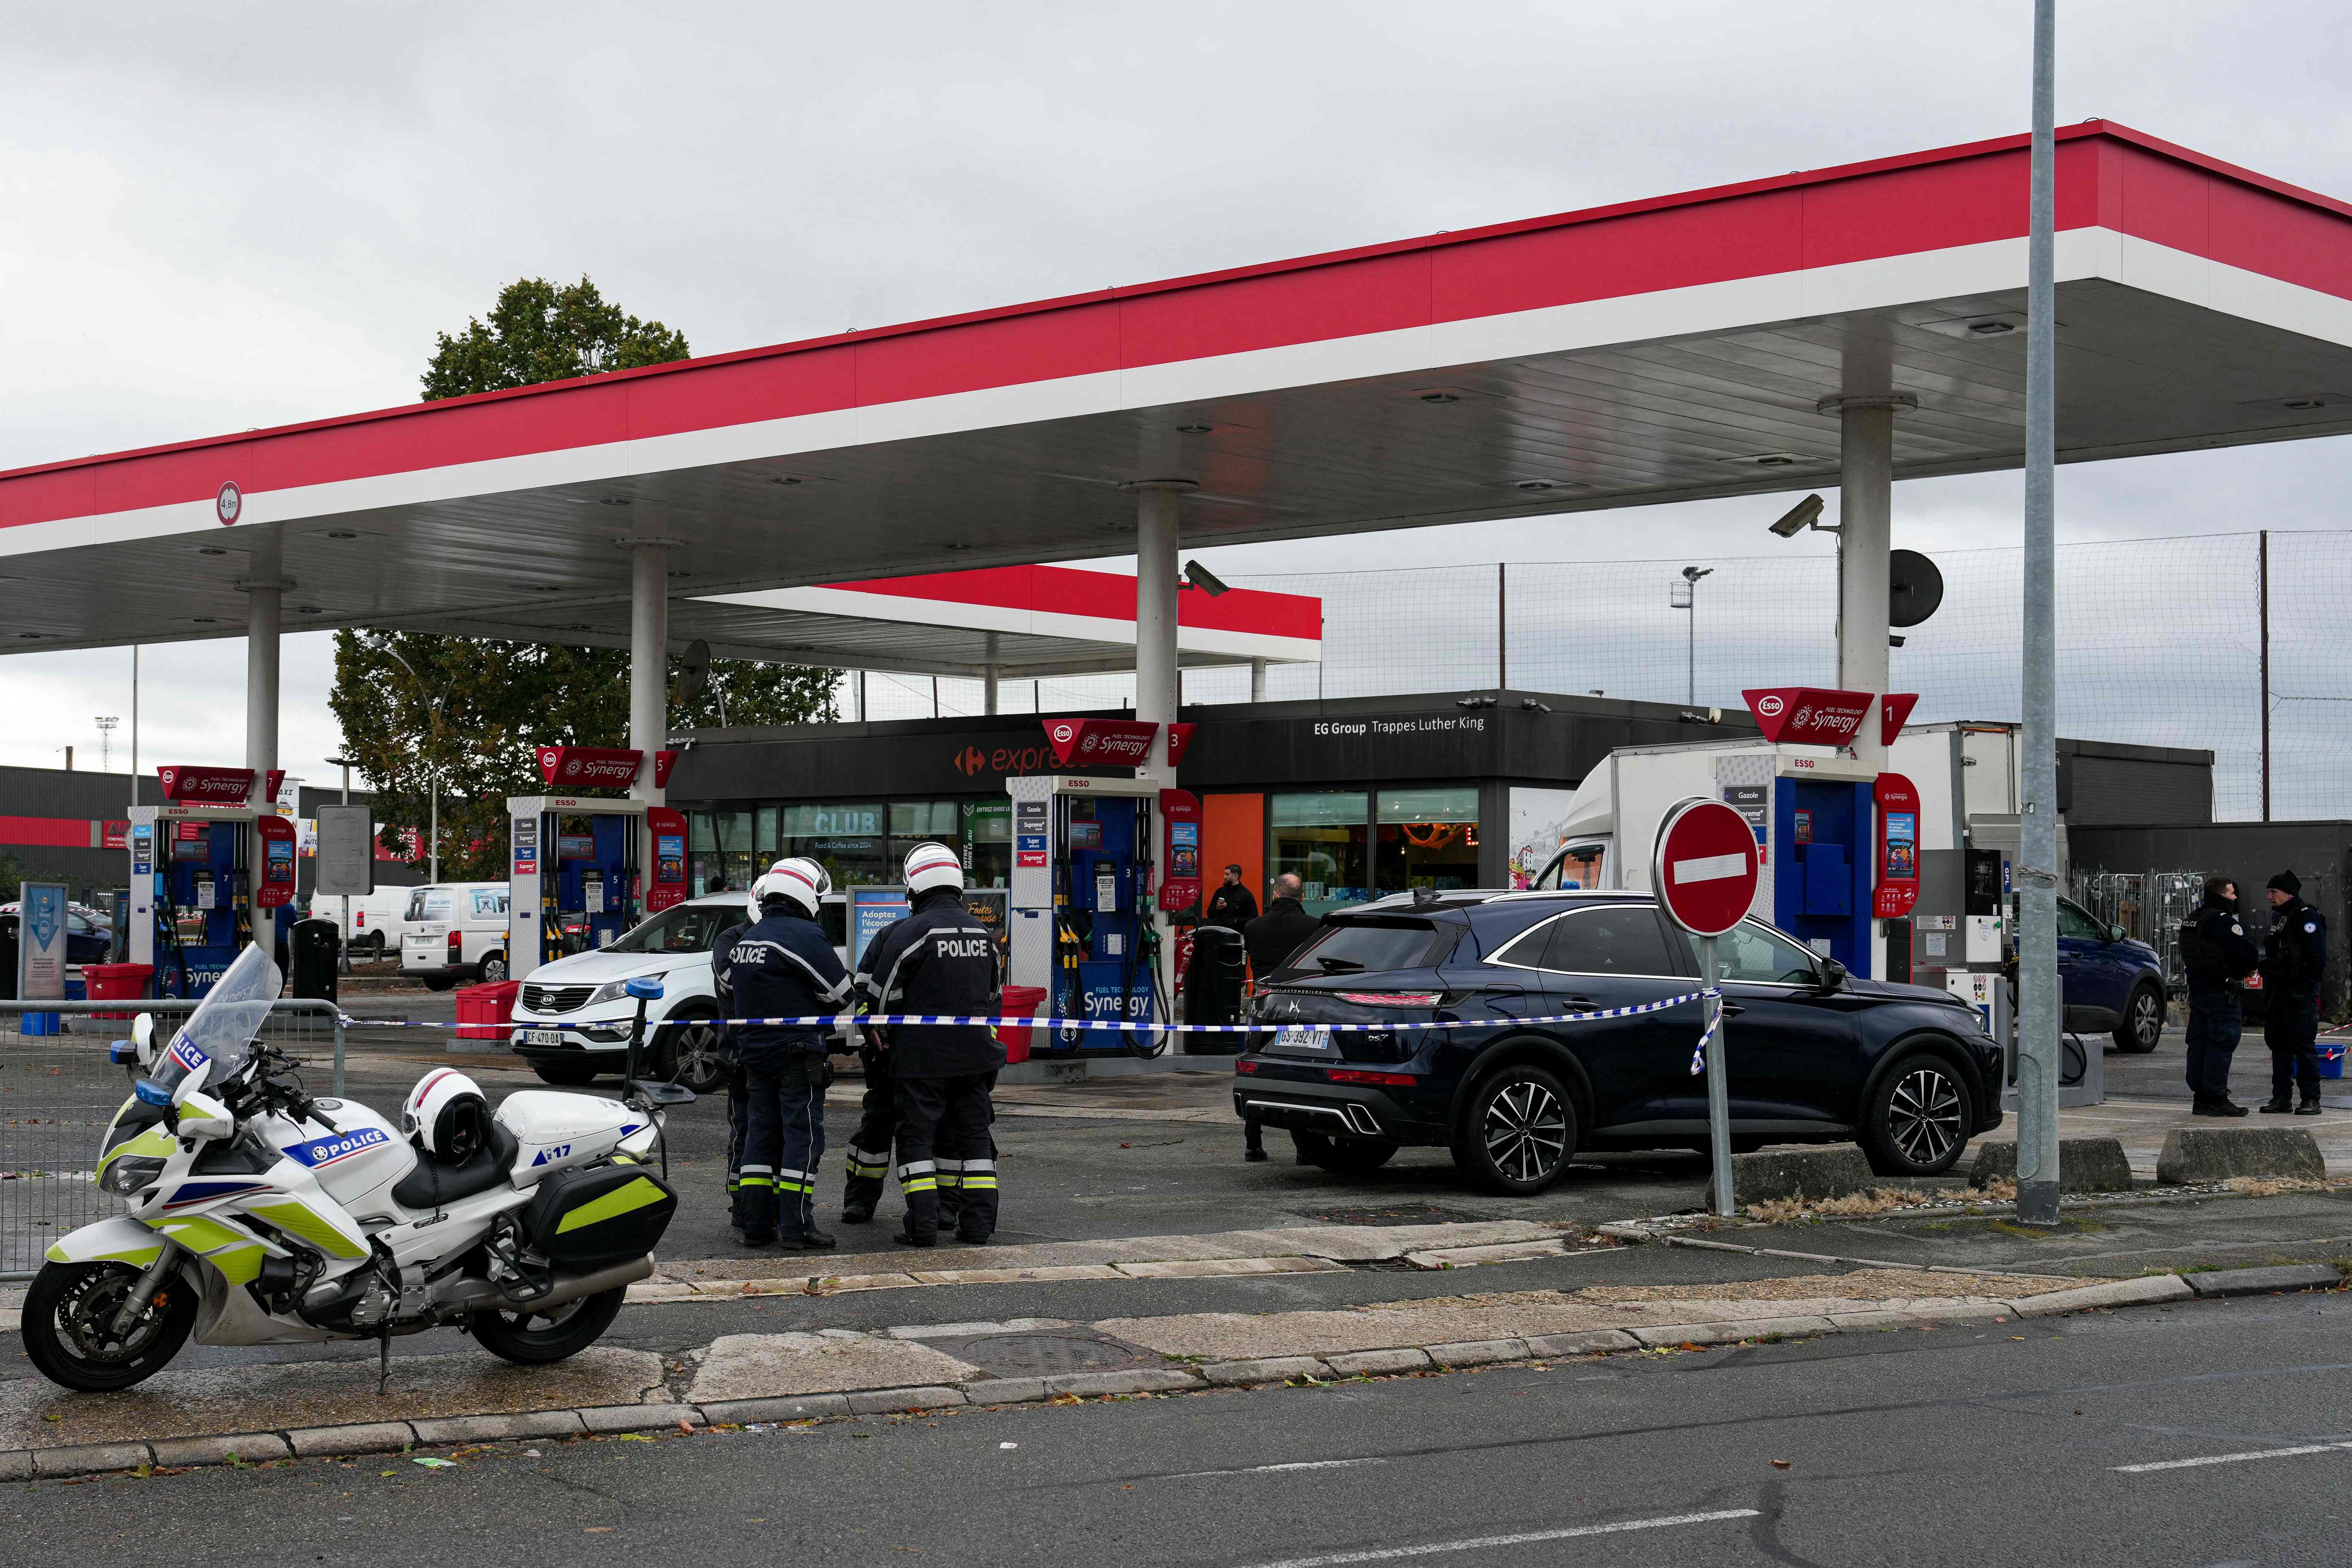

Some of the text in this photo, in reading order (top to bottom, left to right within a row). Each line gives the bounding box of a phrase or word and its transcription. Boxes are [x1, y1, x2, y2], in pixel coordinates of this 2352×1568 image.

[221, 499, 237, 510] 4,8m
[1763, 701, 1779, 710] Esso
[1811, 710, 1859, 733] Synergy
[1886, 706, 1893, 722] 1
[1315, 717, 1484, 736] EG Group Trappes Luther King
[1099, 736, 1147, 755] Synergy
[1171, 734, 1178, 747] 3
[584, 762, 634, 779] Synergy
[658, 760, 662, 771] 5
[1795, 759, 1814, 768] ESSO
[200, 779, 246, 794] Synergy
[268, 778, 273, 787] 7
[816, 812, 875, 833] CLUB
[1126, 869, 1130, 877] 3
[862, 910, 897, 919] Adoptez
[968, 902, 993, 914] Faites
[937, 940, 988, 958] POLICE
[187, 968, 223, 987] Syne
[1084, 992, 1149, 1017] Synegy
[527, 1031, 559, 1044] CF-470-DA
[1281, 1030, 1324, 1045] GS-392-VT
[328, 1130, 383, 1156] POLICE
[553, 1144, 571, 1158] 17
